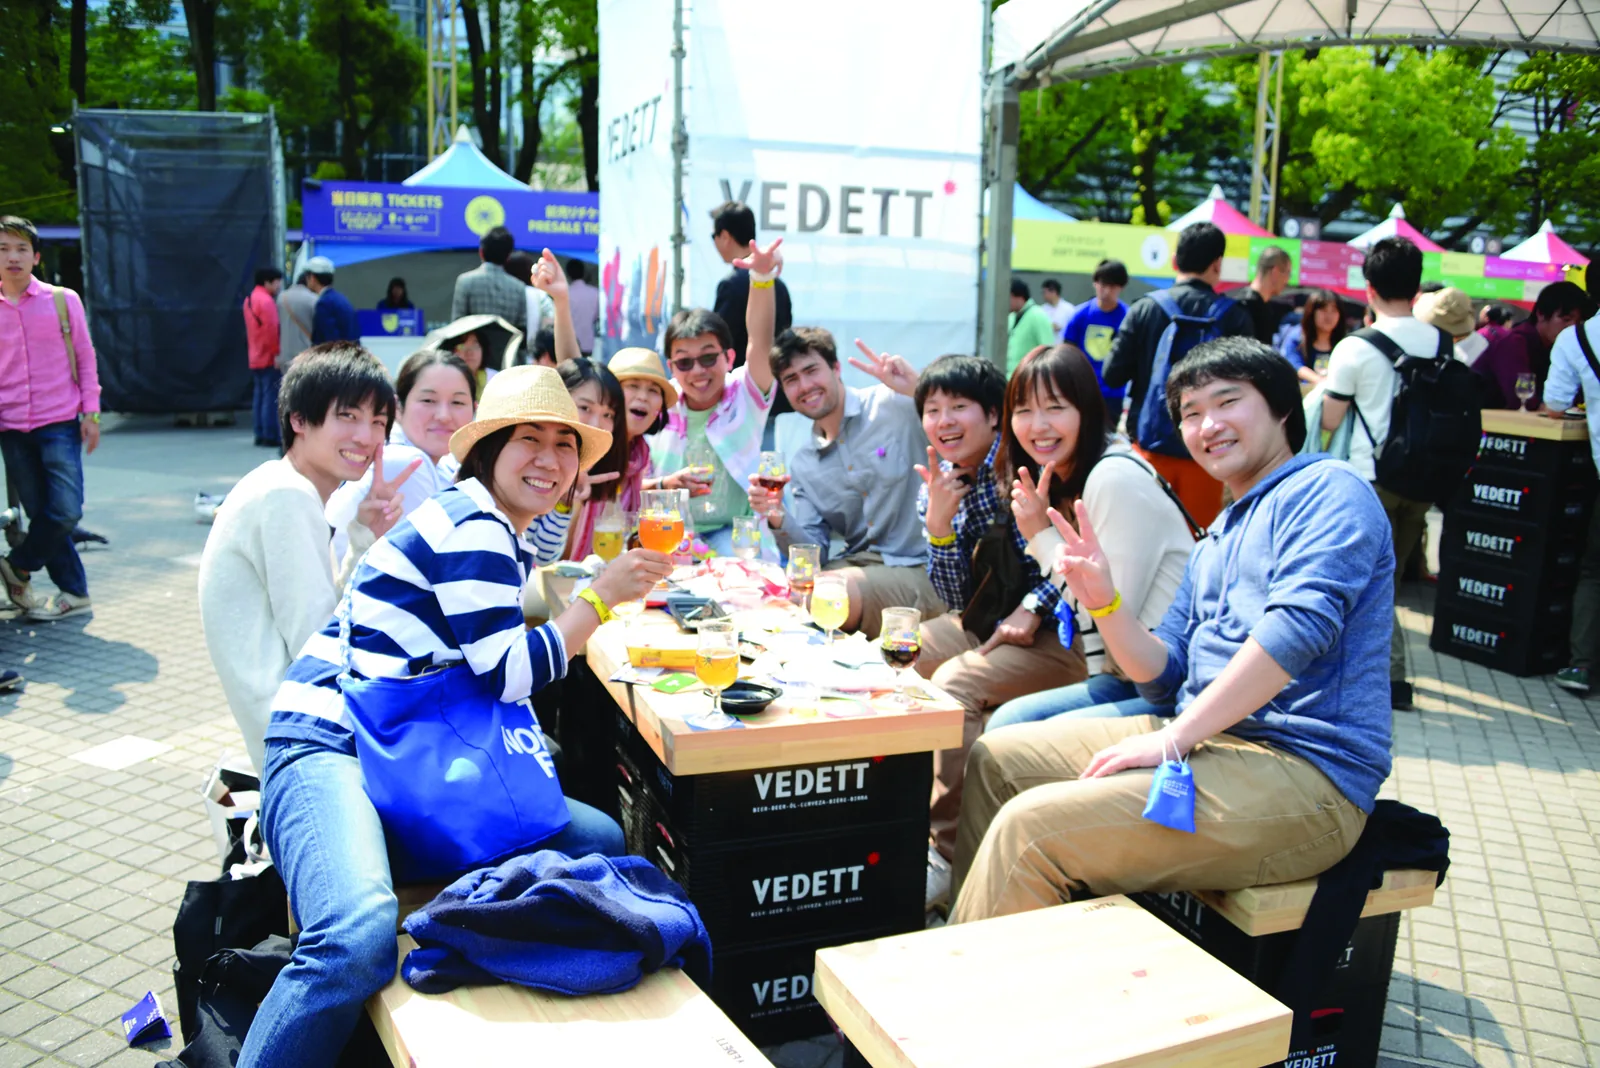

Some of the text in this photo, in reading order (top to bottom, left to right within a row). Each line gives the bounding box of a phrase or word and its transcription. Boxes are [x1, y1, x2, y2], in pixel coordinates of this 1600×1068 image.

[386, 193, 444, 209] TICKETS
[719, 178, 934, 237] VEDETT
[1473, 483, 1523, 505] VEDETT
[1466, 530, 1514, 553] VEDETT
[1459, 577, 1506, 601] VEDETT
[1452, 623, 1498, 647] VEDETT
[754, 762, 870, 800] VEDETT
[752, 865, 865, 905] VEDETT
[752, 974, 815, 1006] VED
[1288, 1044, 1335, 1058] EXTRA BLOND
